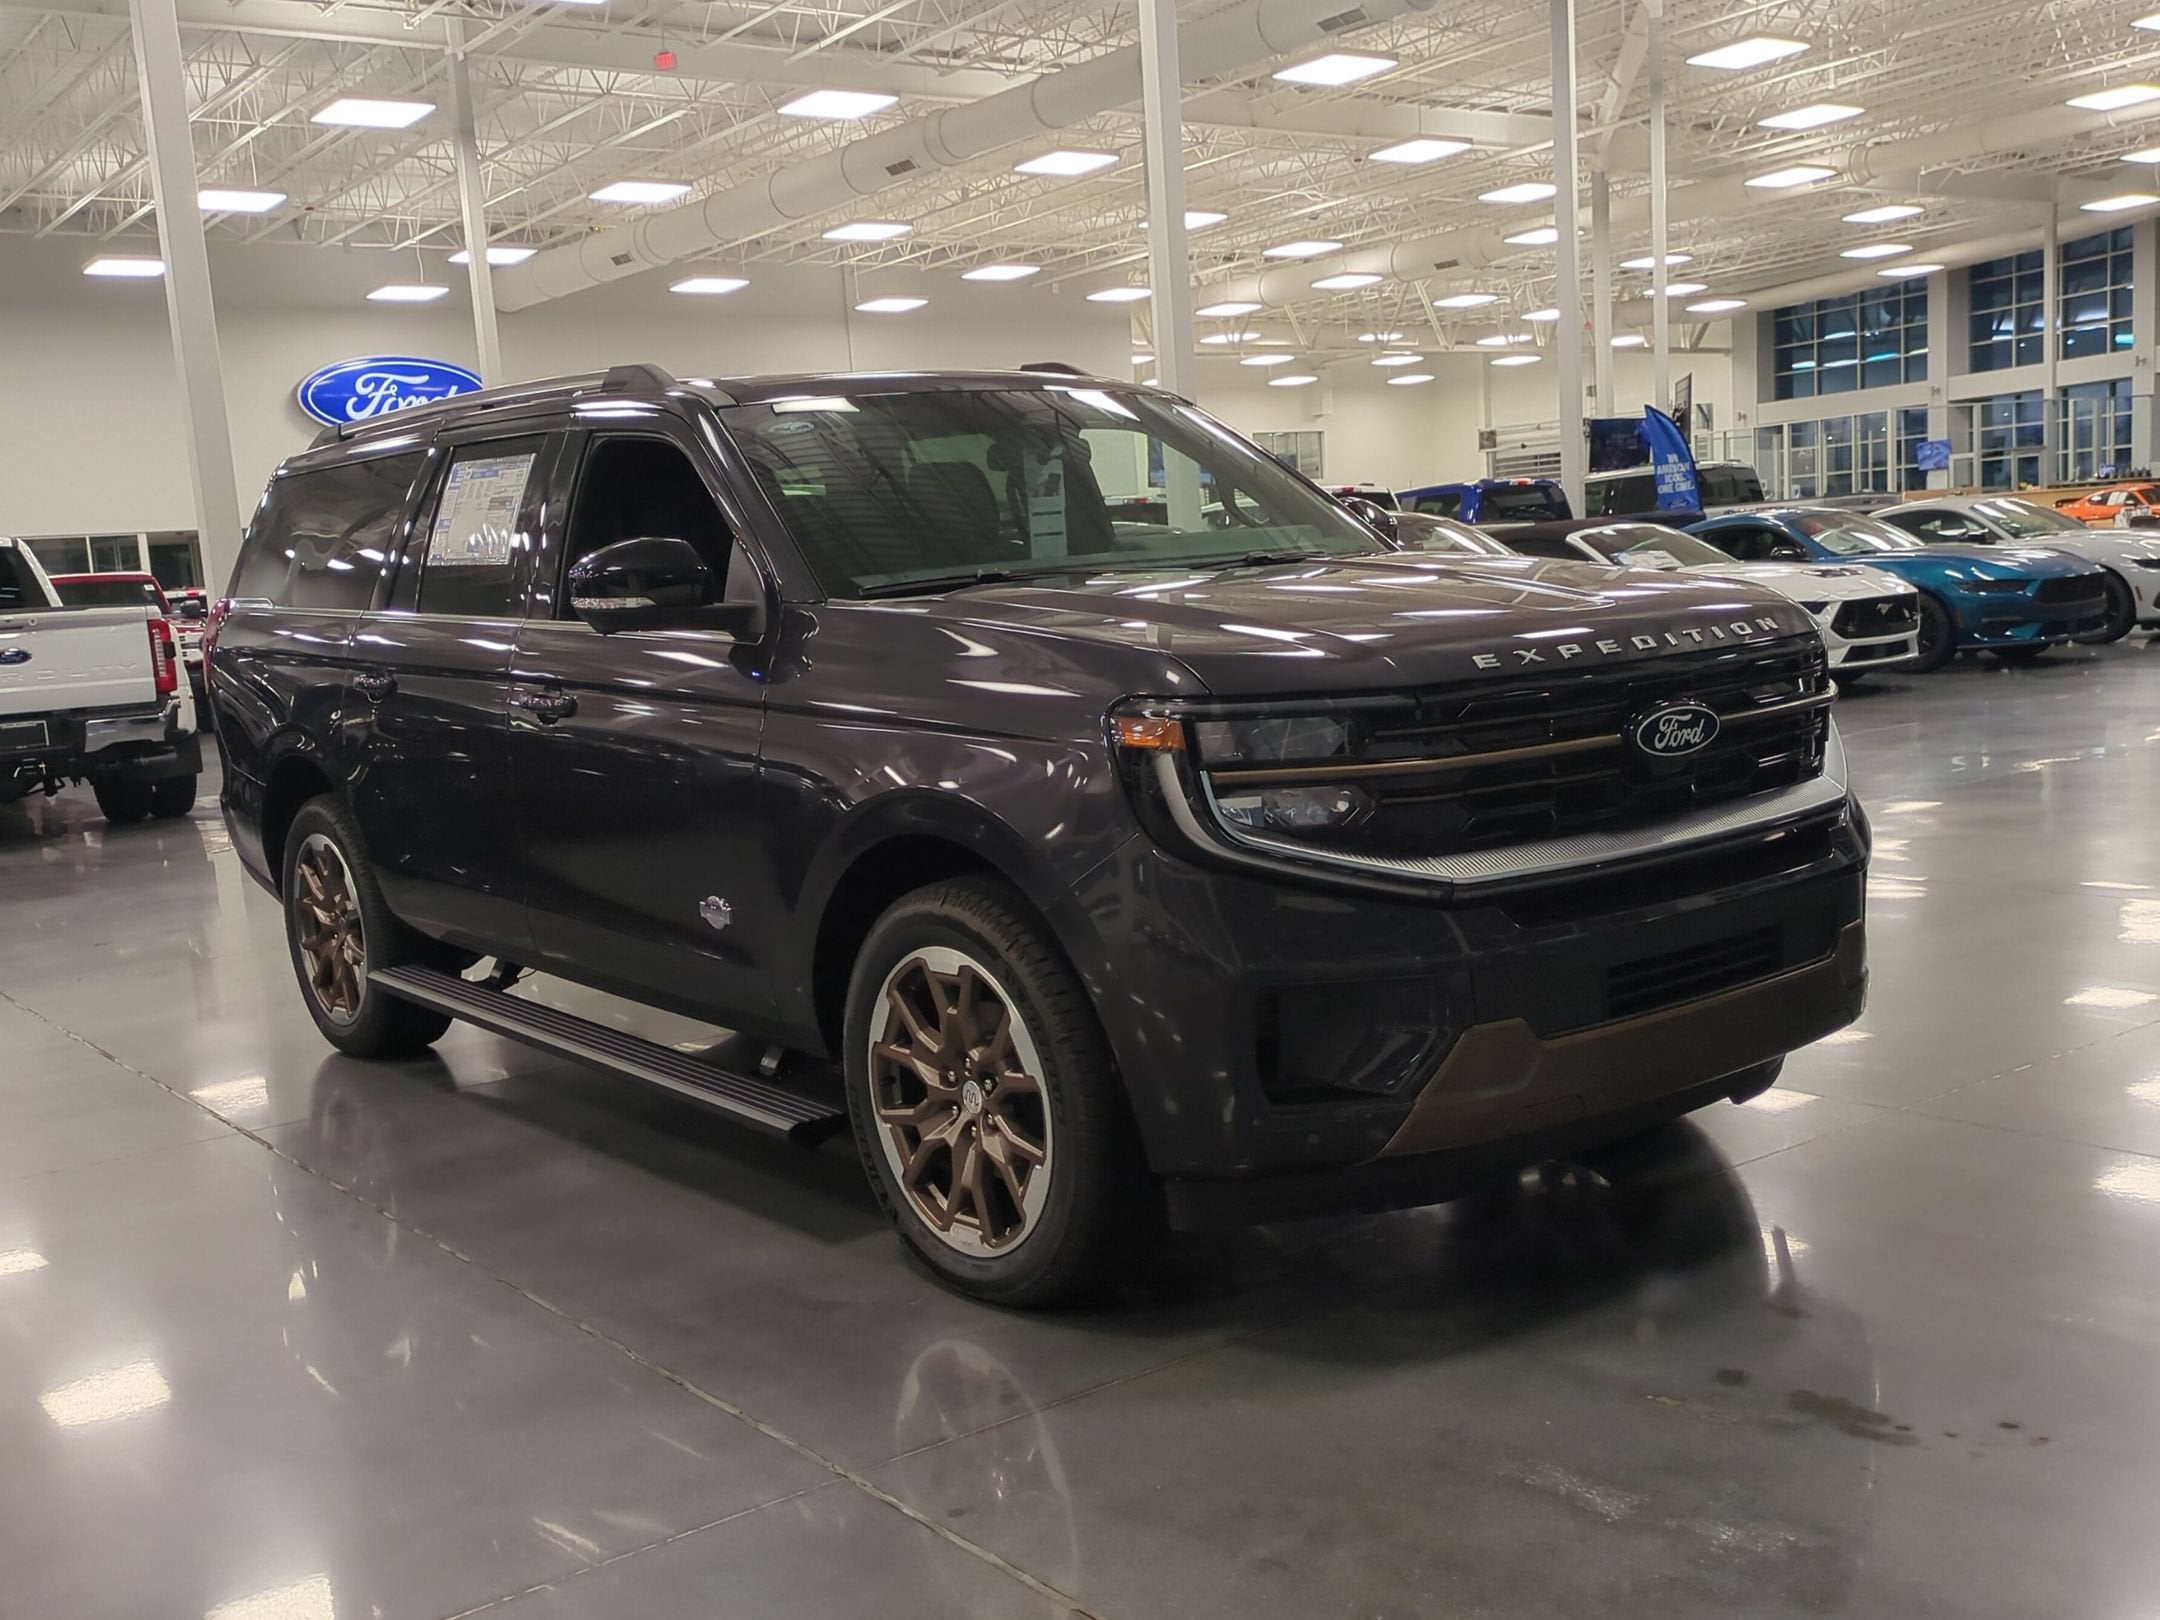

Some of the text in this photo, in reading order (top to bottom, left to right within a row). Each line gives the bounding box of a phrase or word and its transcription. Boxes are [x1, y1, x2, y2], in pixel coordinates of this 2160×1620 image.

[346, 373, 458, 420] For
[1472, 617, 1779, 669] EXPEDITION
[1655, 713, 1704, 749] Ford
